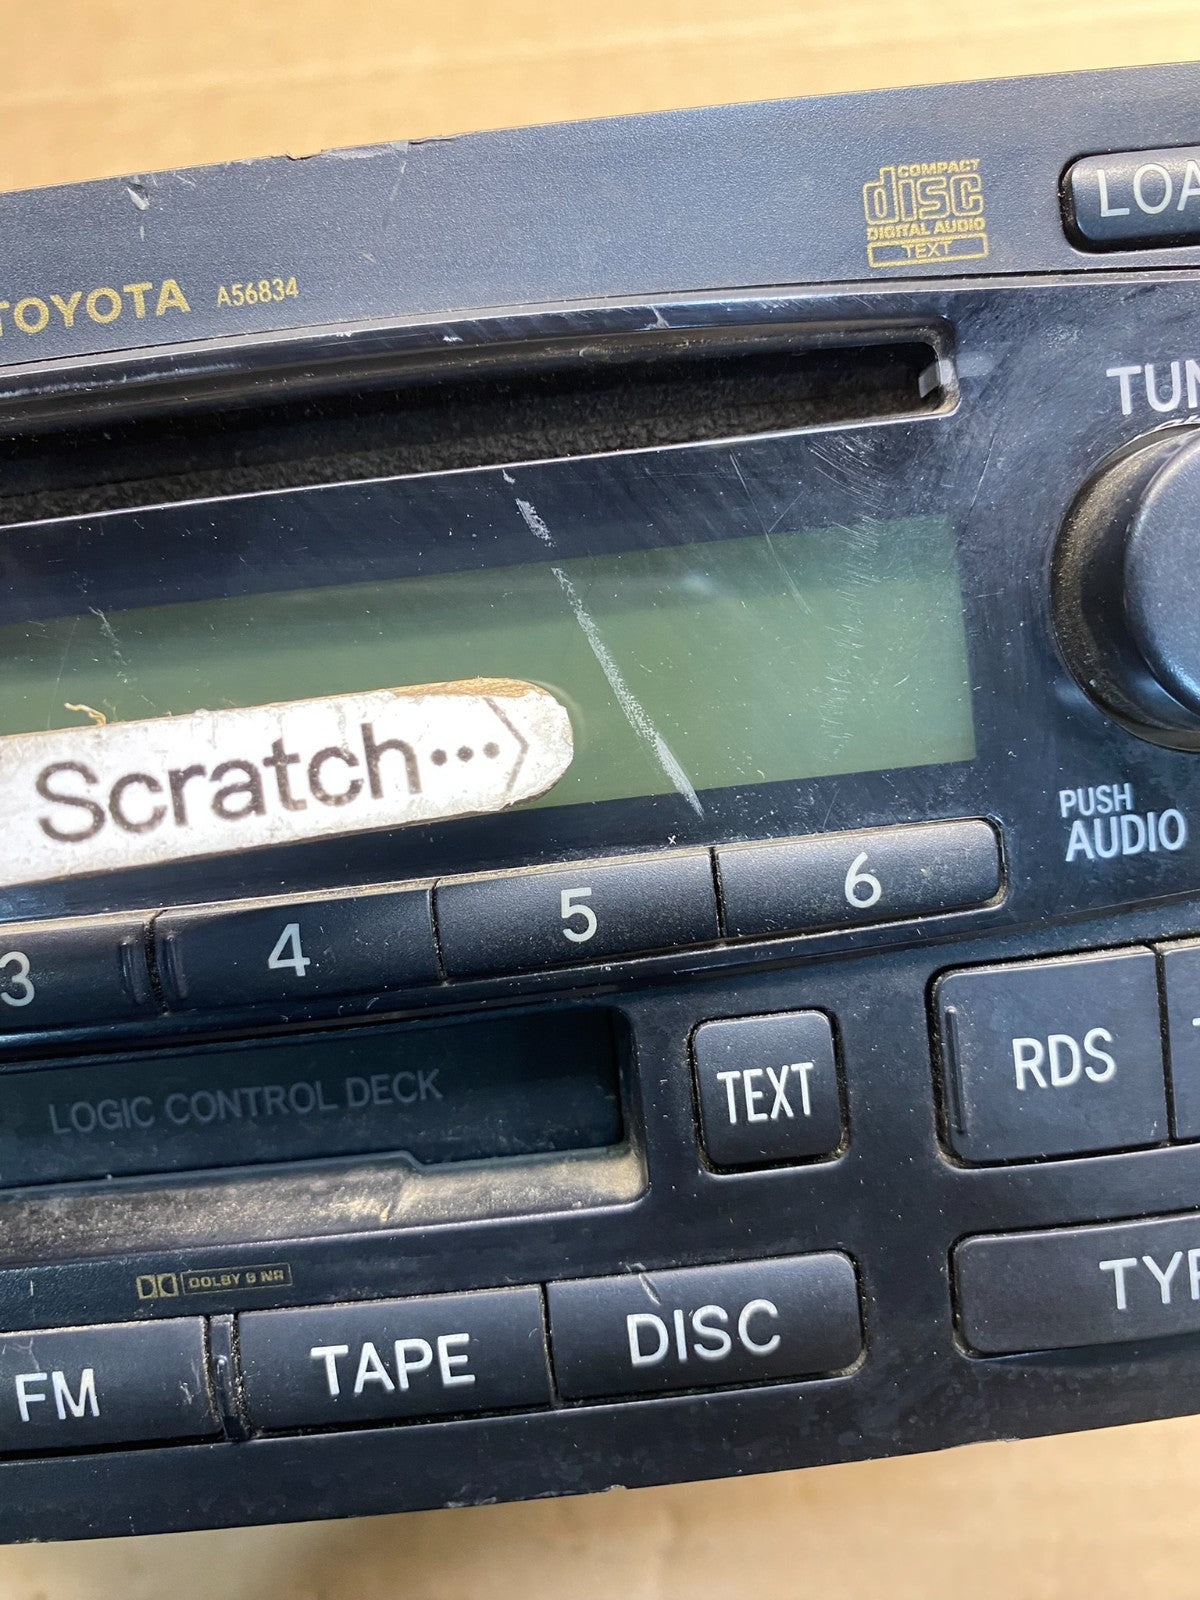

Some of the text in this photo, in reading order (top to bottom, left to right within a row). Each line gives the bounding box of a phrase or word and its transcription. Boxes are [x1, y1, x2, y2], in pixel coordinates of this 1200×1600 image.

[898, 159, 980, 177] COMPACT
[867, 217, 986, 241] DIGITAL AUDIO
[902, 241, 952, 258] TEXT
[216, 276, 299, 308] A56834
[1060, 783, 1133, 818] PUSH
[1065, 809, 1187, 862] AUDIO
[845, 852, 882, 908] 6
[560, 886, 598, 943] 5
[267, 923, 311, 977] 4
[0, 950, 35, 1007] 3
[1012, 1027, 1117, 1091] RDS
[50, 1068, 443, 1135] LOGIC CONTROL DECK
[716, 1062, 814, 1124] TEXT
[189, 1273, 241, 1289] DOLBY
[260, 1269, 284, 1282] NR
[627, 1299, 782, 1367] DISC
[311, 1333, 476, 1395] TAPE
[15, 1369, 100, 1422] FM
